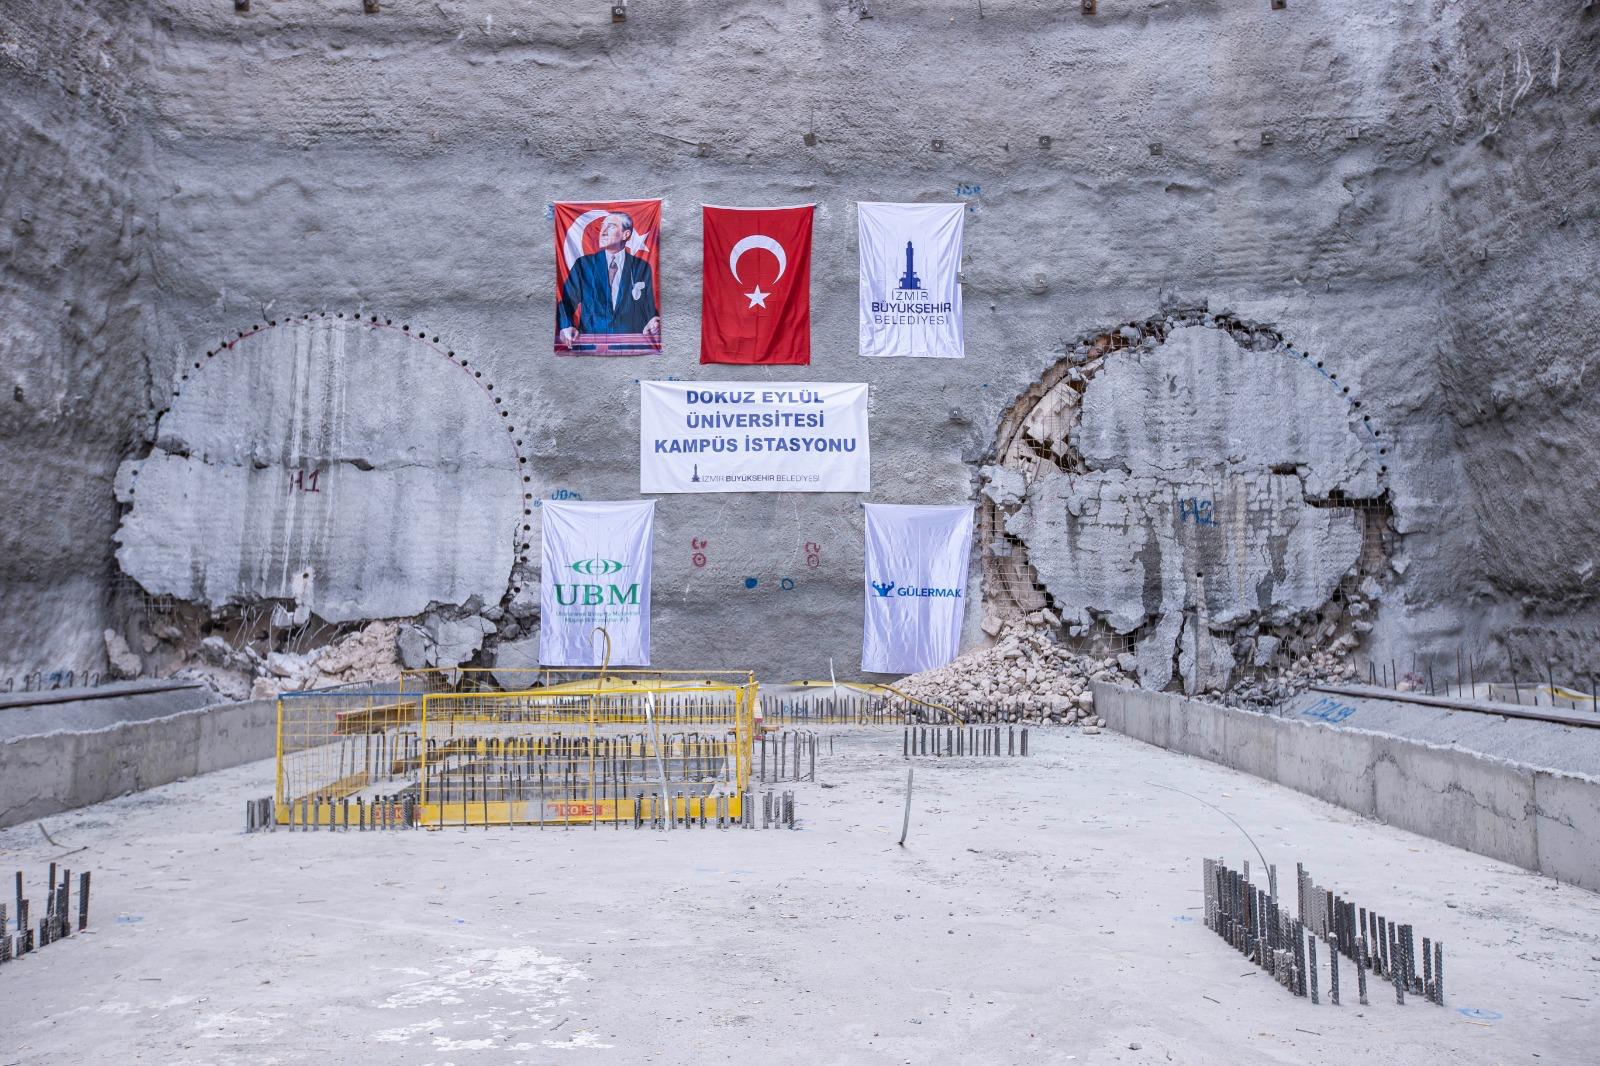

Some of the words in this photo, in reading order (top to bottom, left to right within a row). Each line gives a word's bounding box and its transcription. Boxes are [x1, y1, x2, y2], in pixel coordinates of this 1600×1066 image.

[686, 390, 755, 404] DOKUZ
[762, 389, 824, 404] EYLÜL
[686, 410, 824, 429] ÜNİVERSİTESİ
[654, 435, 738, 453] KAMPÜS
[745, 434, 856, 452] İSTASYONU
[288, 468, 321, 495] H1
[554, 582, 641, 606] UBM
[897, 585, 962, 598] GÜLERMAK
